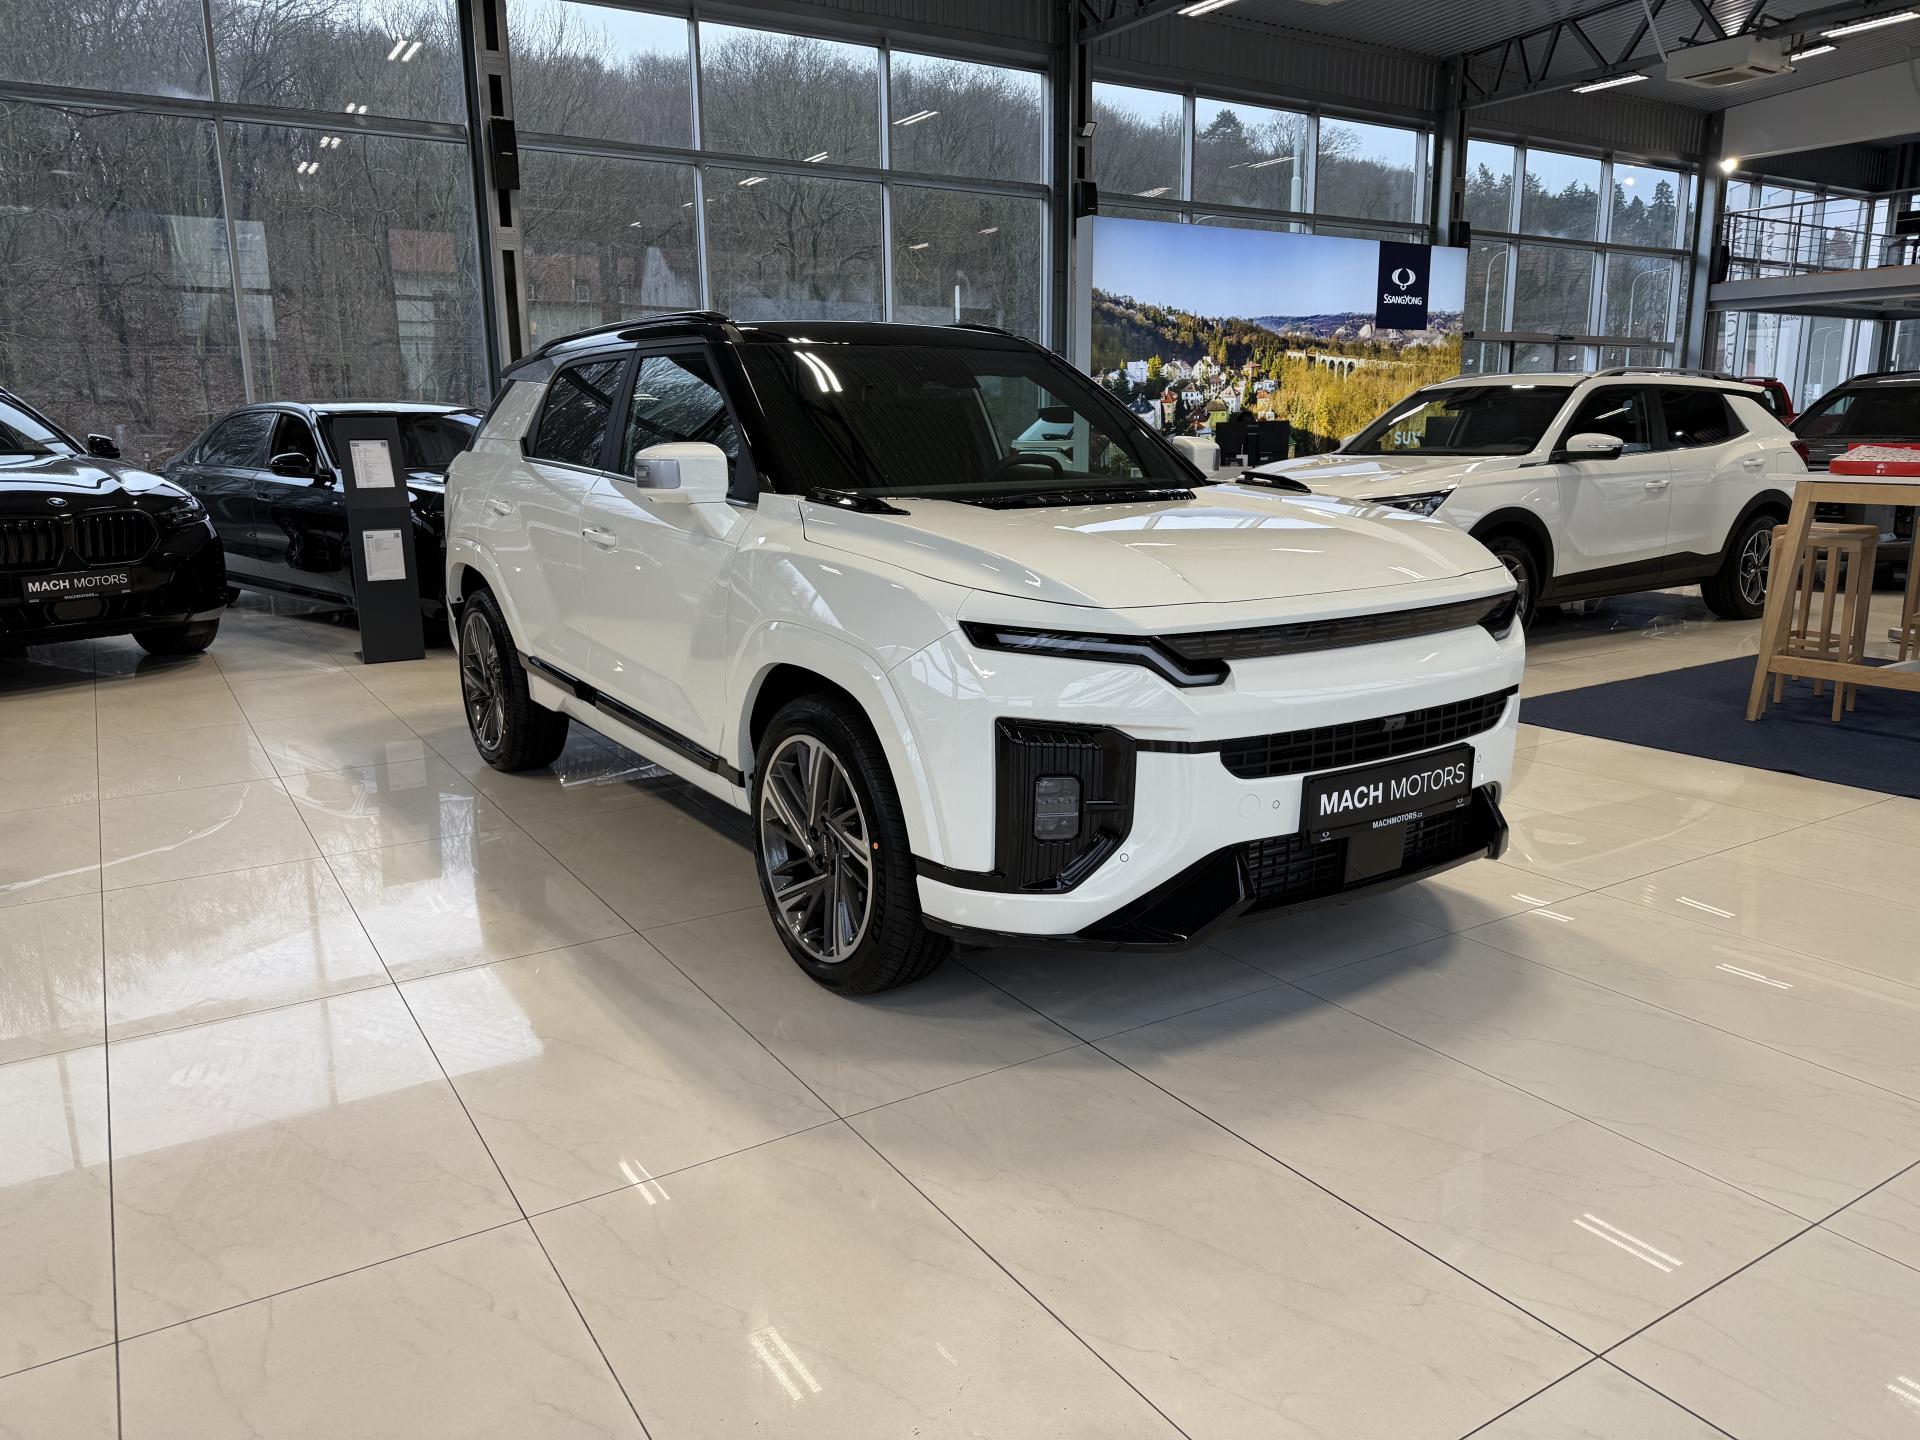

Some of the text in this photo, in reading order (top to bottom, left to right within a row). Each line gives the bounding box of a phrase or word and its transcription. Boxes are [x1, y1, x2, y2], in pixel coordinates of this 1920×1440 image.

[27, 573, 128, 593] MACH MOTORS
[1319, 762, 1465, 816] MACH MOTORS
